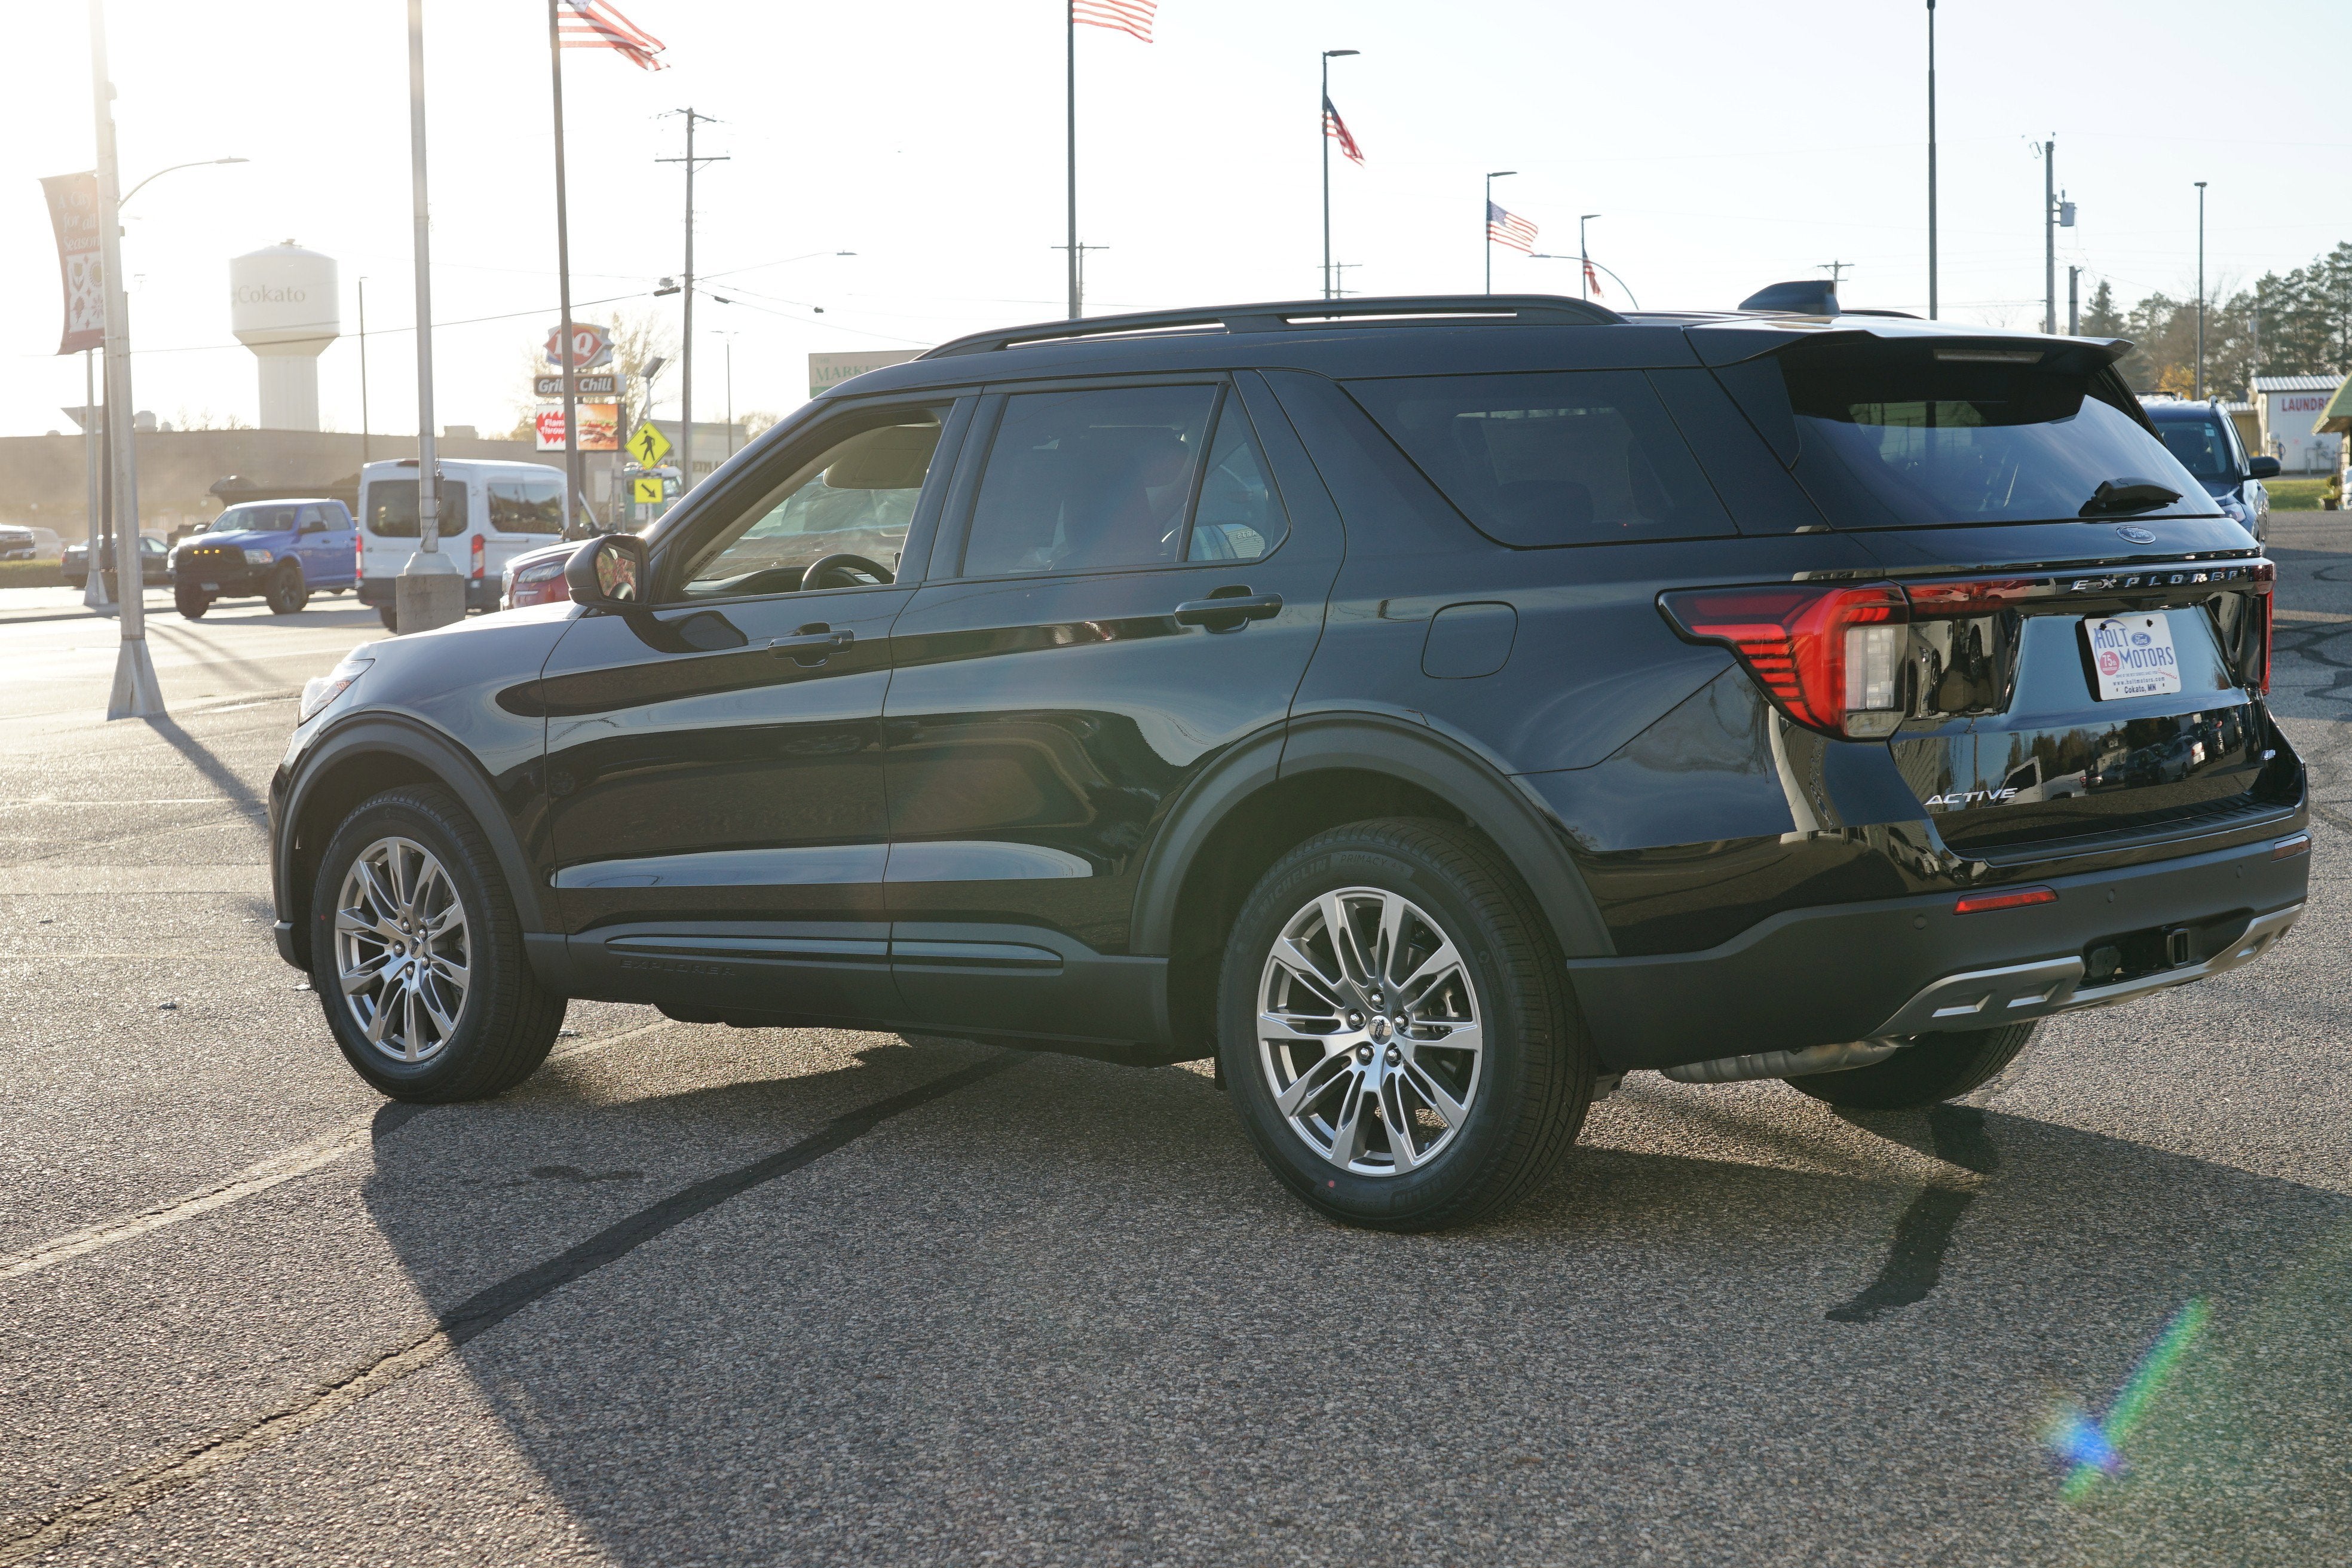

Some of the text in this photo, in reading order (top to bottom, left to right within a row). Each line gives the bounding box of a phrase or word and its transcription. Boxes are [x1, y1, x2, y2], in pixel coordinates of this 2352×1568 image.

[71, 192, 91, 210] City
[64, 212, 96, 232] for all
[64, 234, 100, 251] Season
[238, 284, 306, 304] Cokato
[538, 378, 612, 393] Gril Chill
[540, 426, 565, 434] Throw
[544, 418, 564, 427] Flam
[2071, 570, 2238, 591] EXPLORER
[2094, 627, 2129, 648] HOLT
[2118, 647, 2174, 669] MOTORS
[2124, 683, 2156, 693] Cokato, MN
[1923, 788, 2018, 806] ACTIVE
[1340, 853, 1388, 866] PRIMACY
[620, 958, 736, 976] EXPLORER
